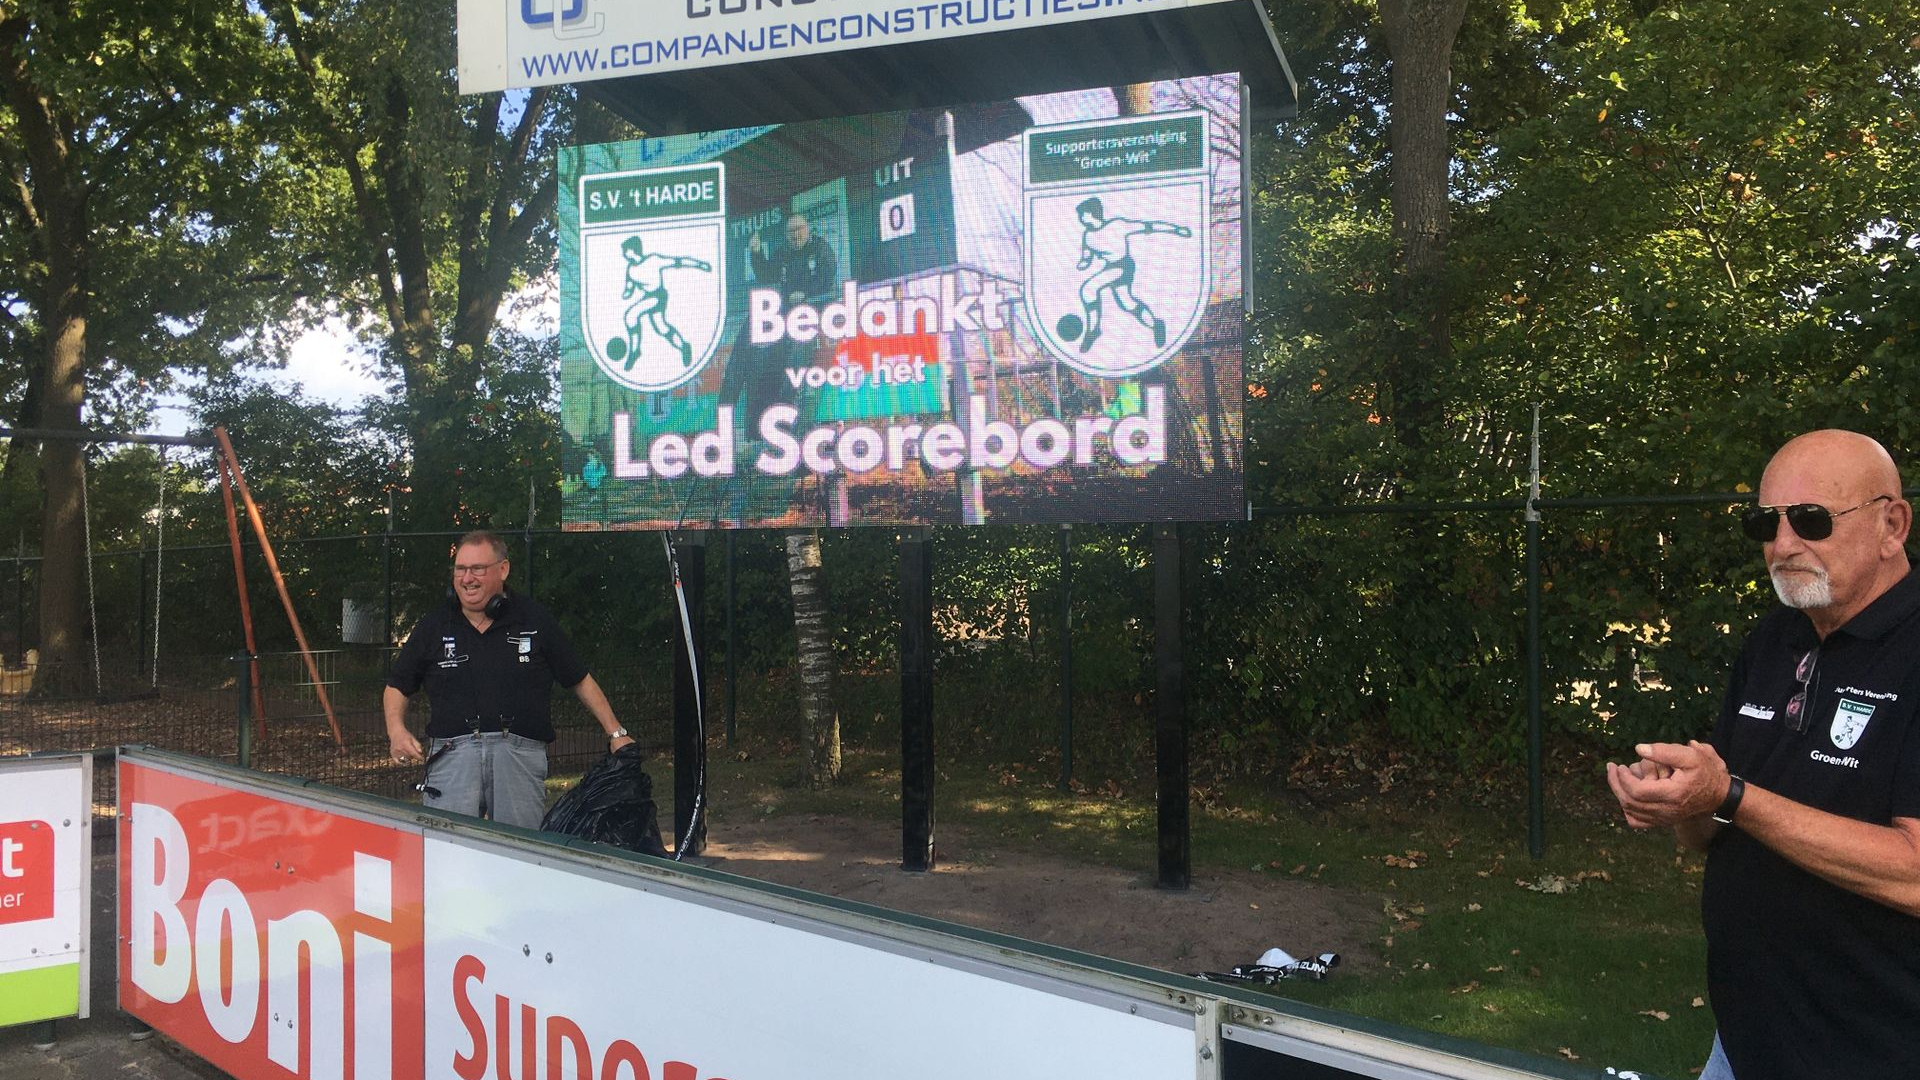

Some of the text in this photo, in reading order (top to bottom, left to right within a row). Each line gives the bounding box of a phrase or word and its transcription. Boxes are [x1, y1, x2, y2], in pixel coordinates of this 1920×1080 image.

[522, 0, 1153, 78] WWW.COMPANJENCONSTRUCTIE.
[1045, 129, 1188, 156] Supportersvereniging
[874, 157, 914, 188] UIT
[589, 189, 624, 211] S.V.
[645, 181, 715, 206] HARDE
[749, 275, 1005, 344] Bedankt
[785, 353, 926, 388] voor het
[613, 386, 1167, 480] Led Scorebord
[0, 892, 24, 909] er
[131, 801, 392, 1080] Boni
